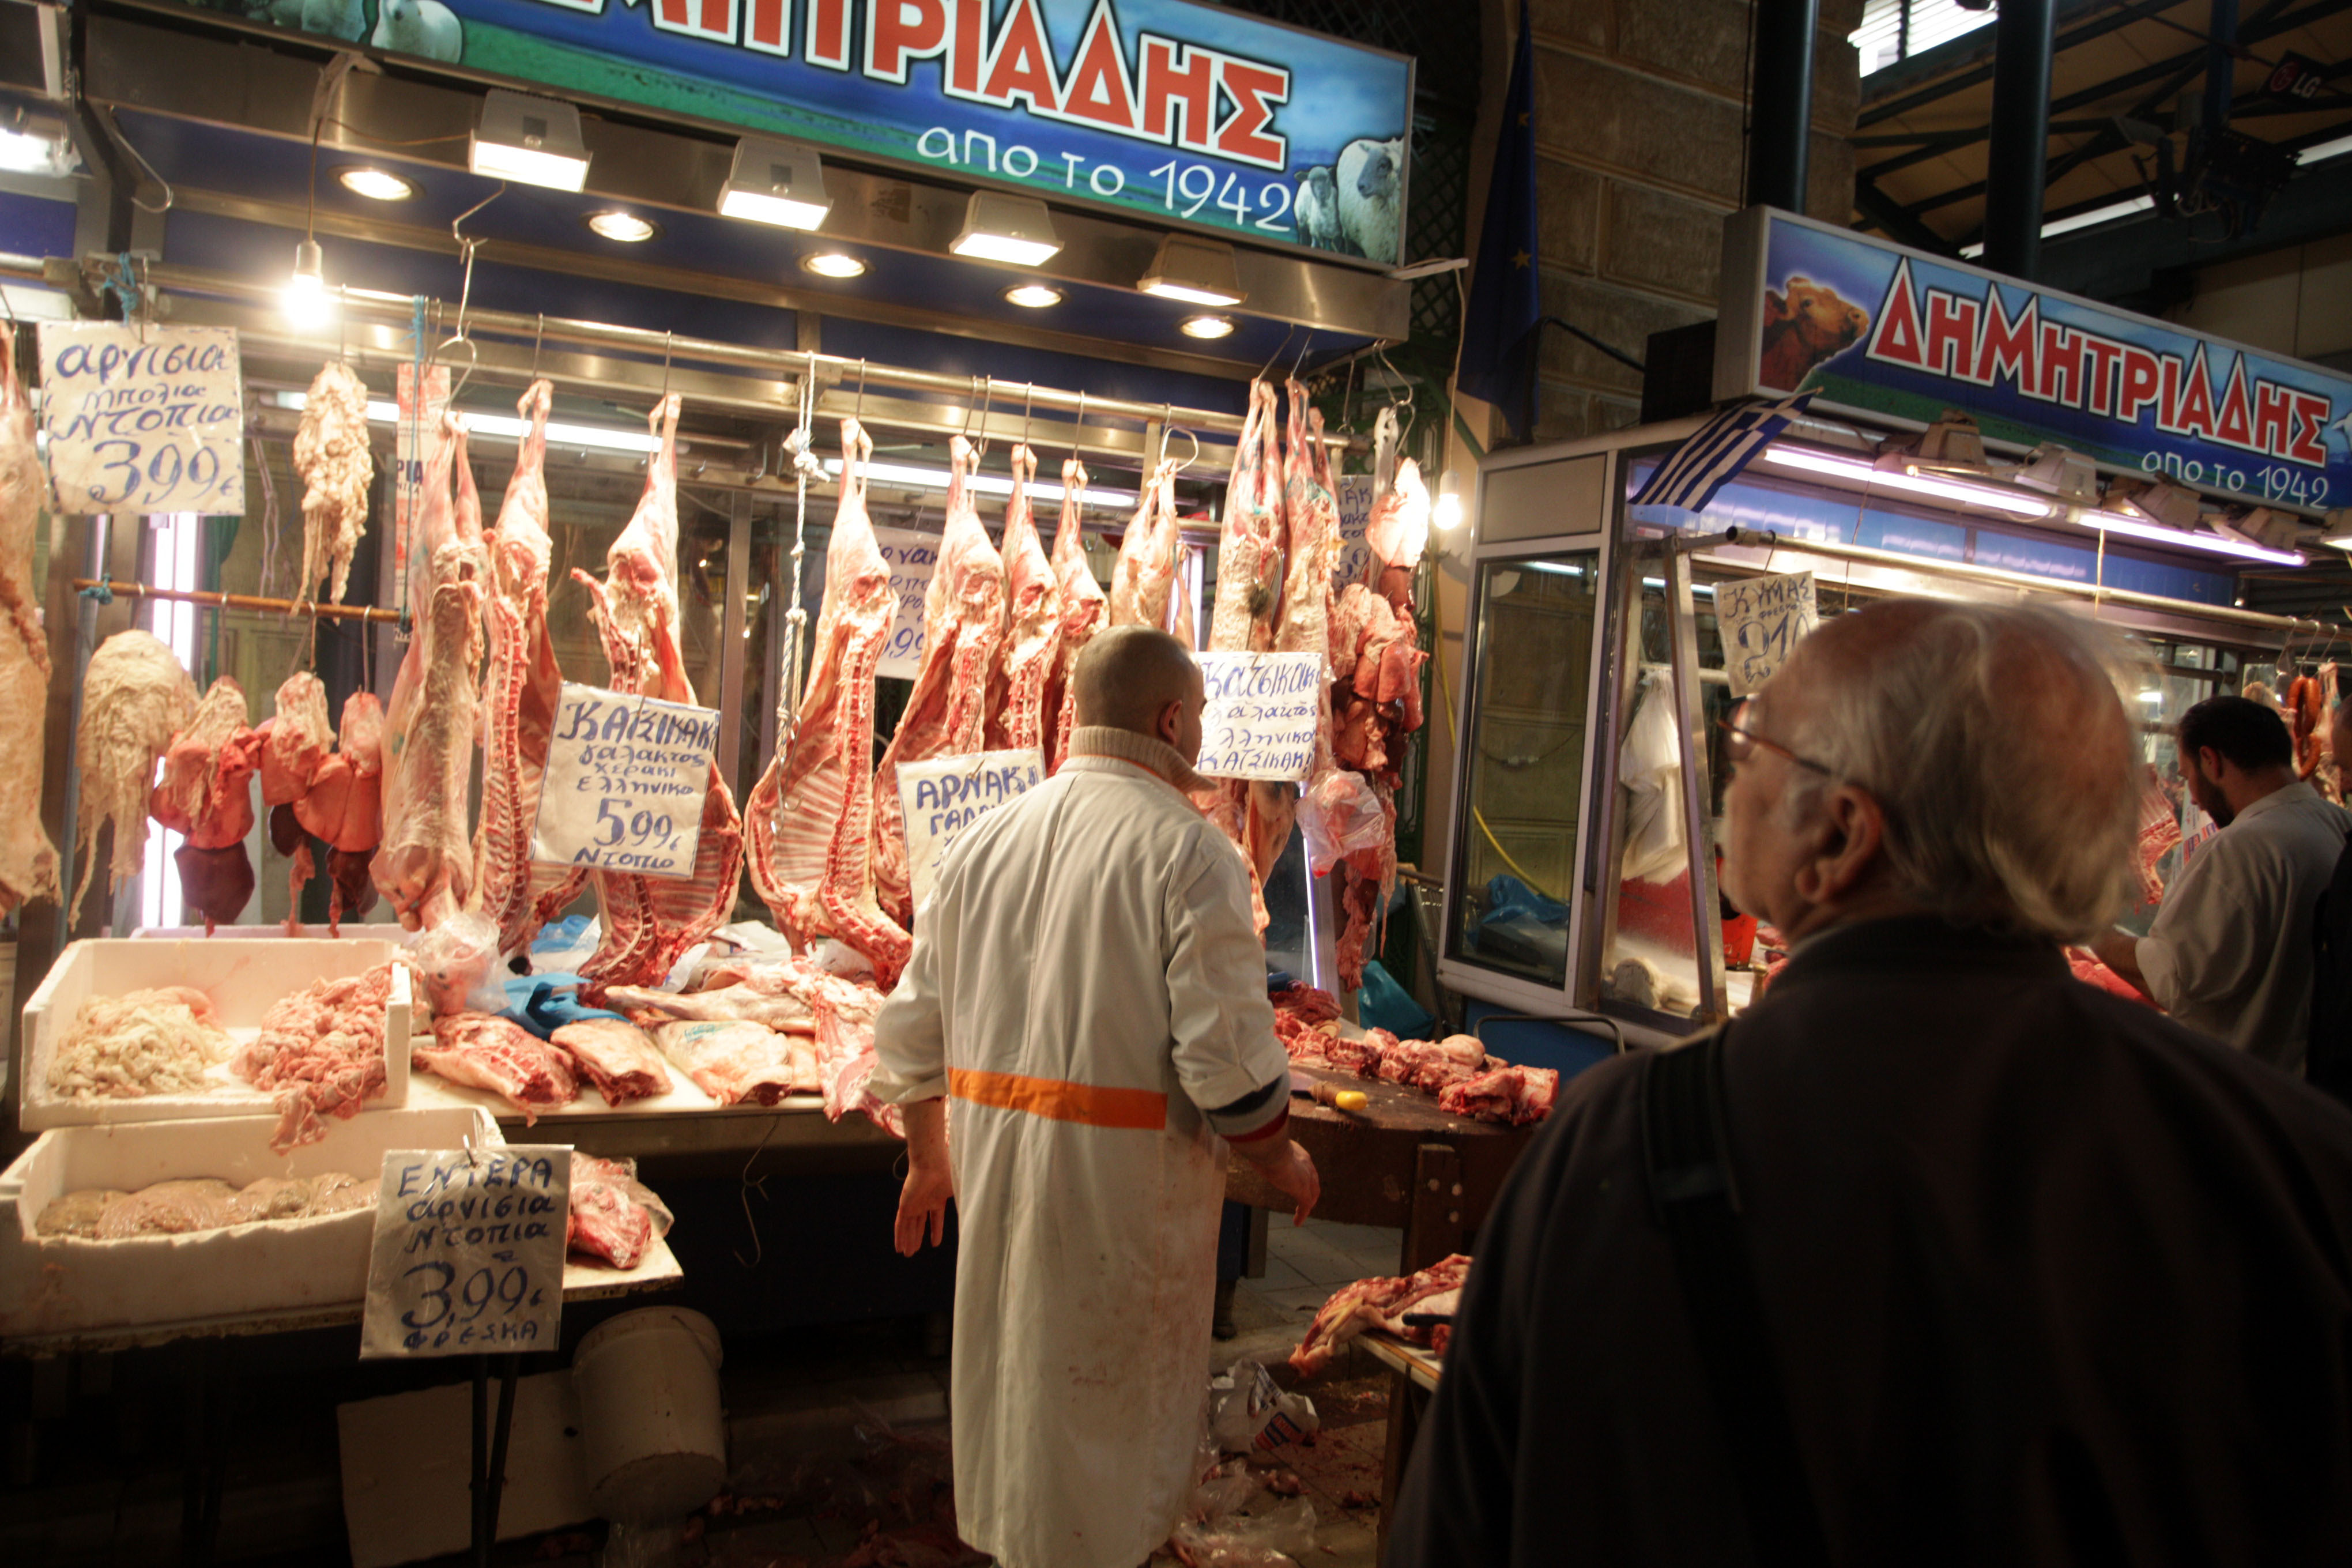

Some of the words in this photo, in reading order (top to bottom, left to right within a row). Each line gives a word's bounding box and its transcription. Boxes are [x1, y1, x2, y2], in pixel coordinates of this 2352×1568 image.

[503, 0, 1290, 171] ΡΙΑΔΗΣ
[2290, 72, 2321, 99] LG
[1149, 160, 1291, 232] 1942
[1864, 255, 2332, 468] ΔΗΜΗΤΡΙΑΔΗΣ
[2256, 465, 2329, 510] 1942
[579, 744, 705, 767] γαλακτος
[398, 1157, 553, 1198] ΕΝΤΕΡΑ
[404, 1320, 538, 1350] ΦΡΕΣΚΑ
